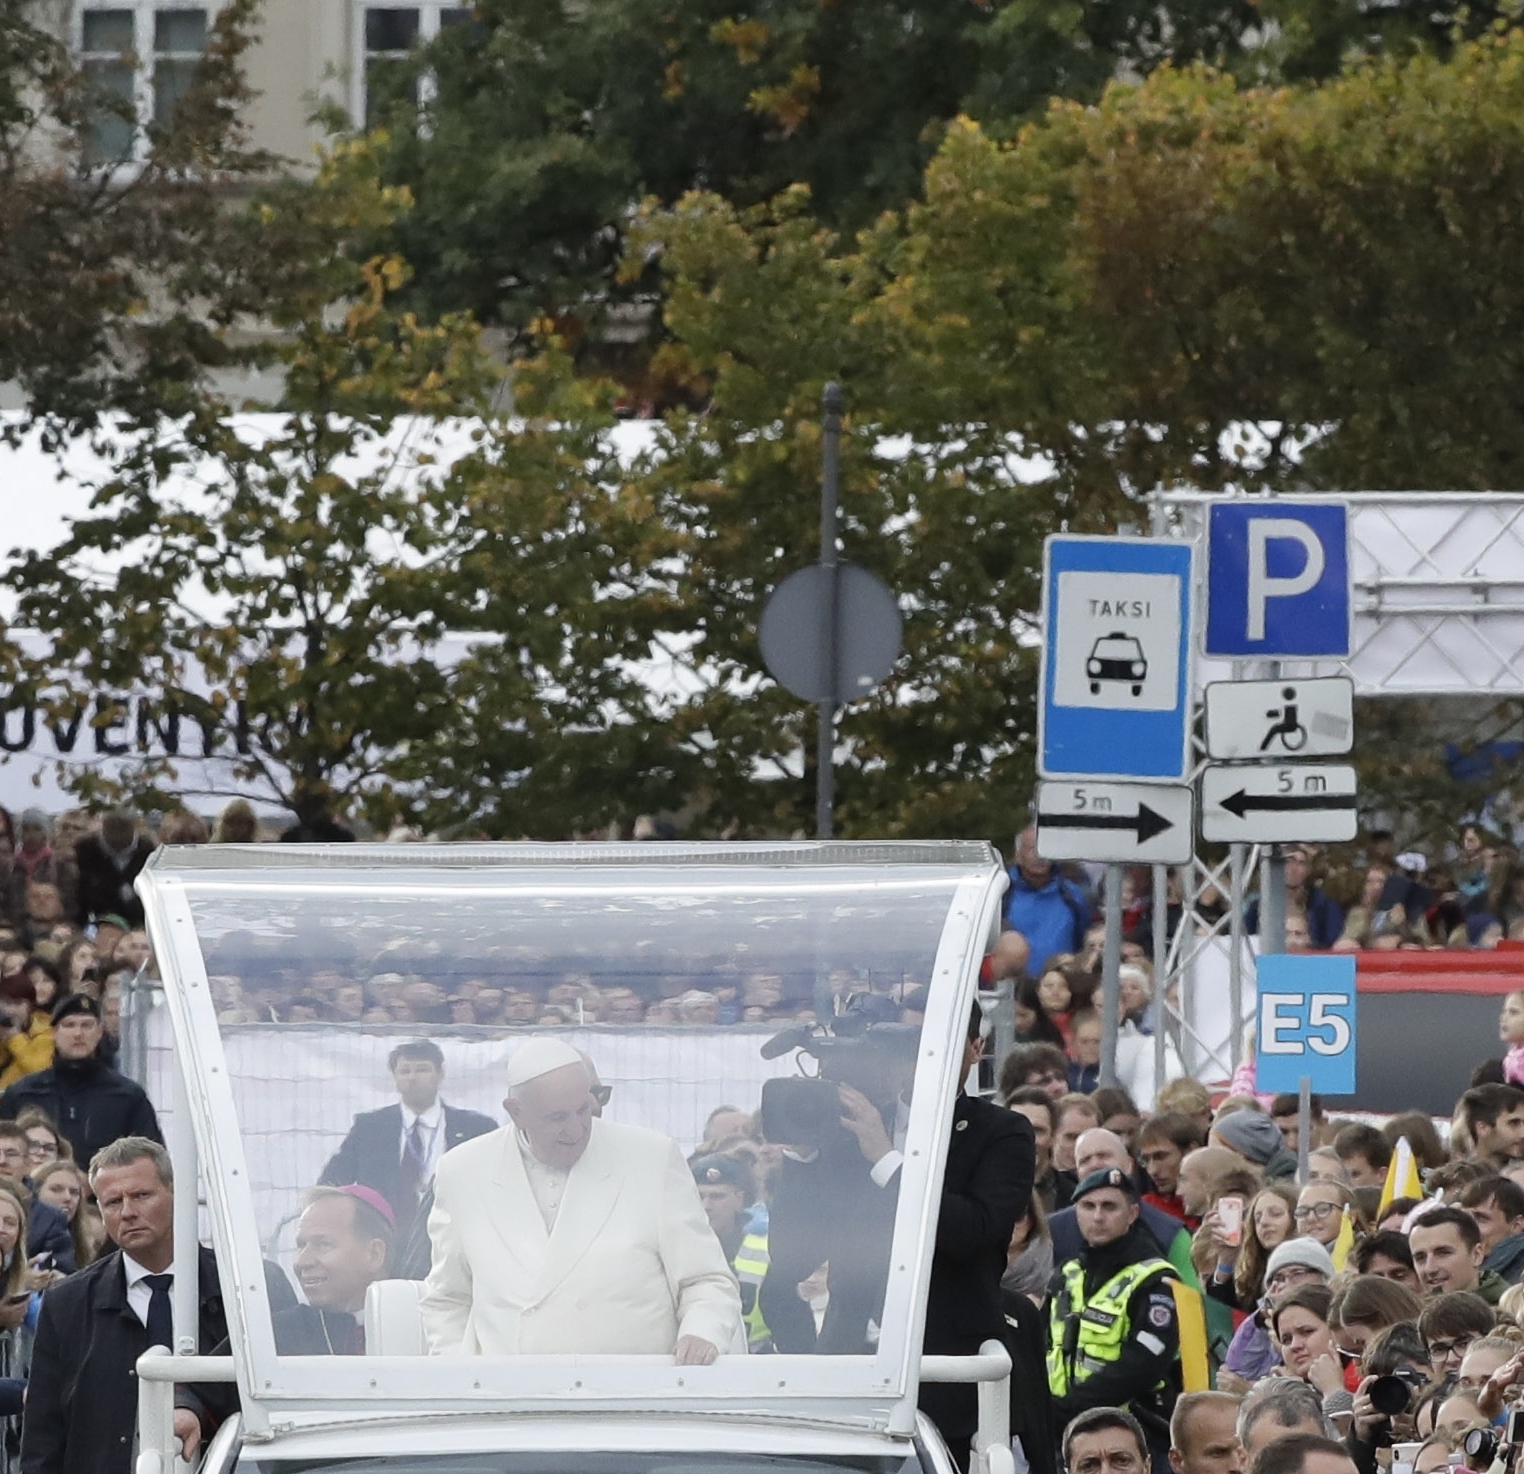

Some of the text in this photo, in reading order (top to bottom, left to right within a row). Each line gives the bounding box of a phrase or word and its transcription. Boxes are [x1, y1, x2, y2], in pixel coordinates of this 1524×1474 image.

[1247, 517, 1325, 641] P
[1089, 599, 1151, 619] TAKSI
[1278, 770, 1292, 793] 5
[1260, 992, 1352, 1056] E5
